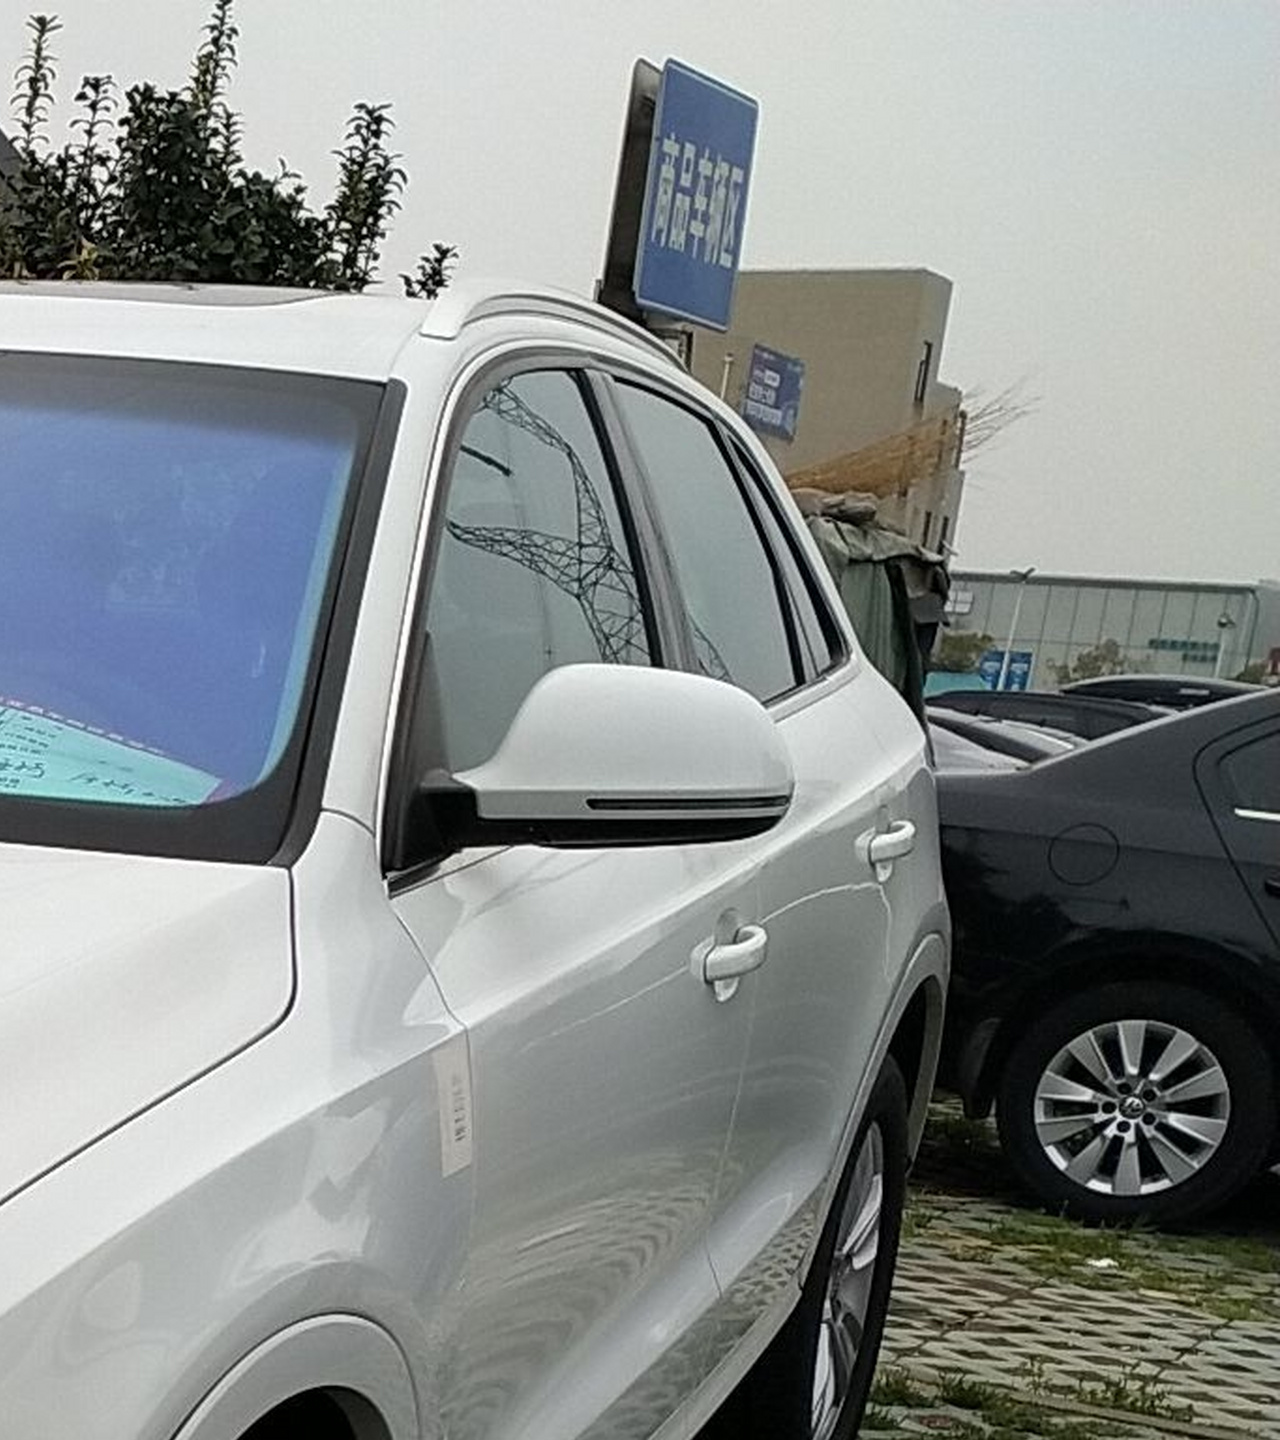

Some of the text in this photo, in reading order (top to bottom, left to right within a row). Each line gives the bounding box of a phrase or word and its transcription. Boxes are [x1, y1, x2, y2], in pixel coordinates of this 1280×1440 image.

[651, 132, 744, 269] 商品车辆区
